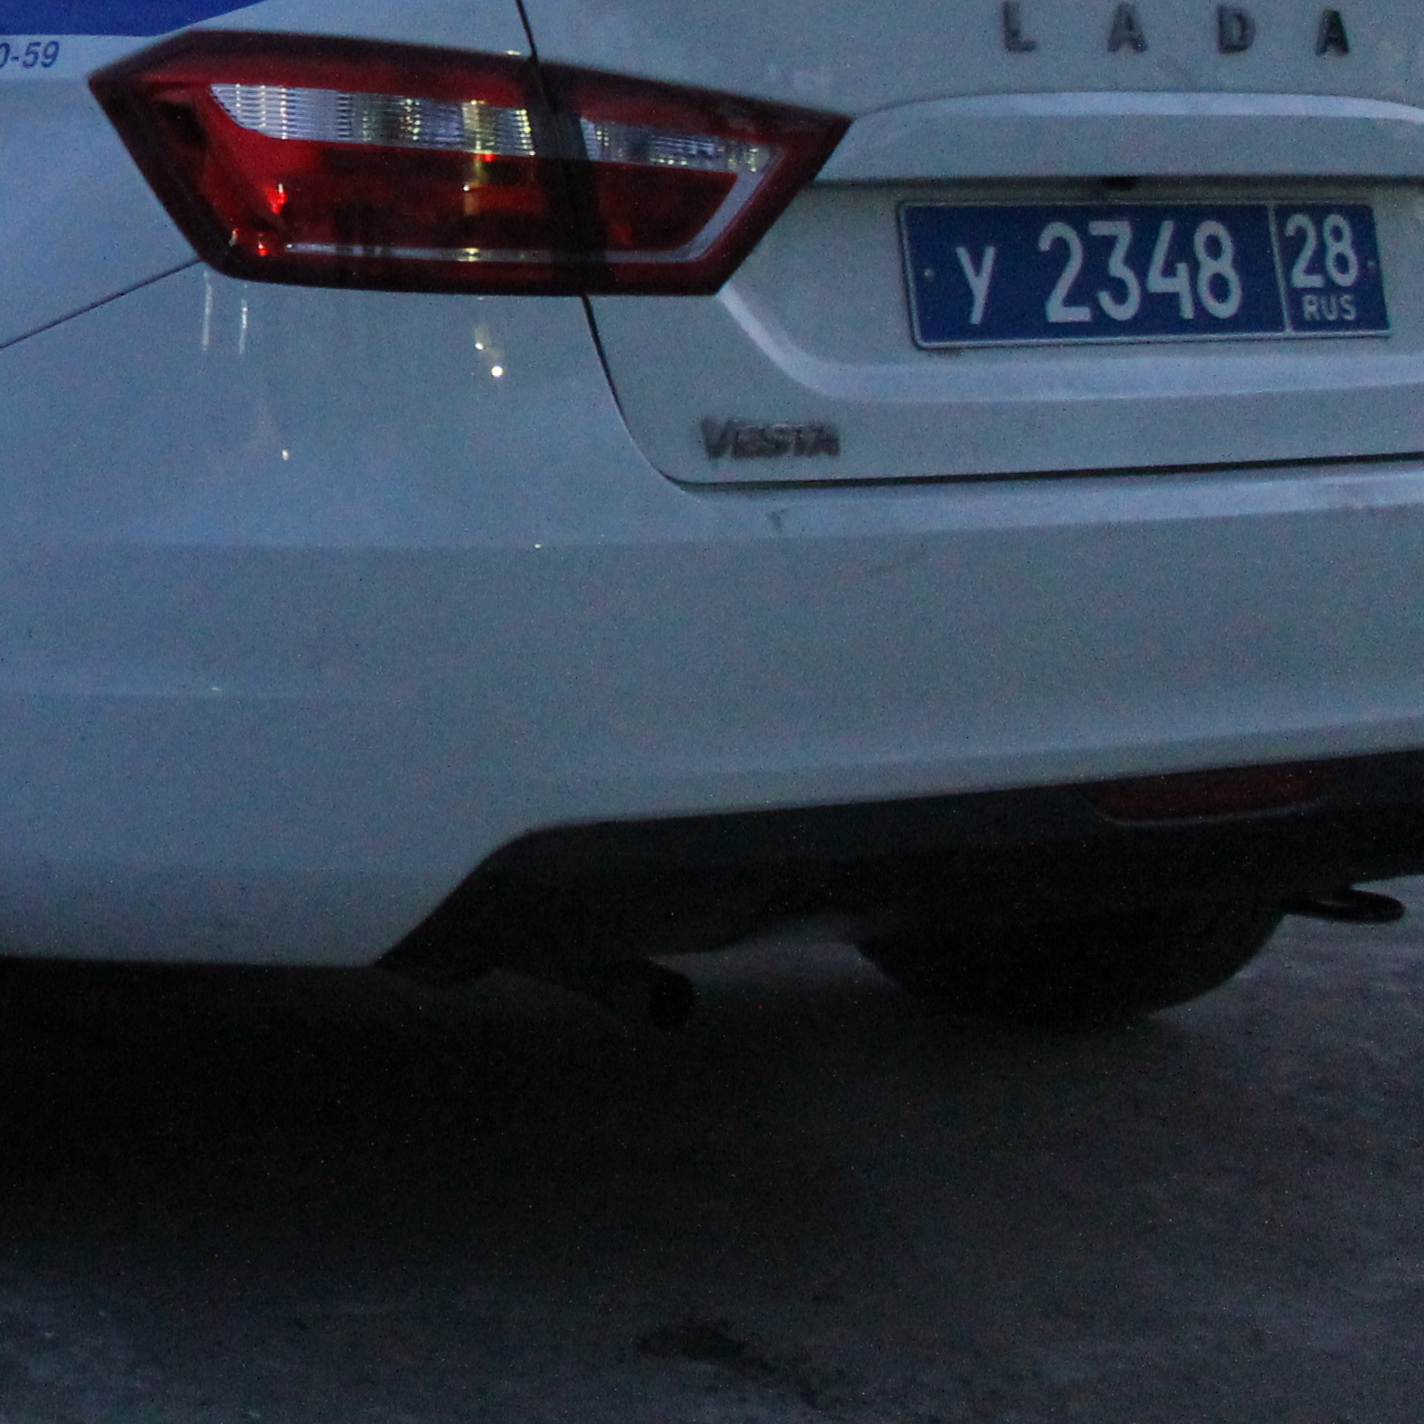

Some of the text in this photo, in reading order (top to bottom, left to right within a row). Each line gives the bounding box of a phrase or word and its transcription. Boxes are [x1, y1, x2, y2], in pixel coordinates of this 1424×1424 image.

[1003, 1, 1351, 55] LADA
[1036, 218, 1243, 323] 2348
[1284, 213, 1358, 288] 28
[1301, 293, 1357, 321] RUS
